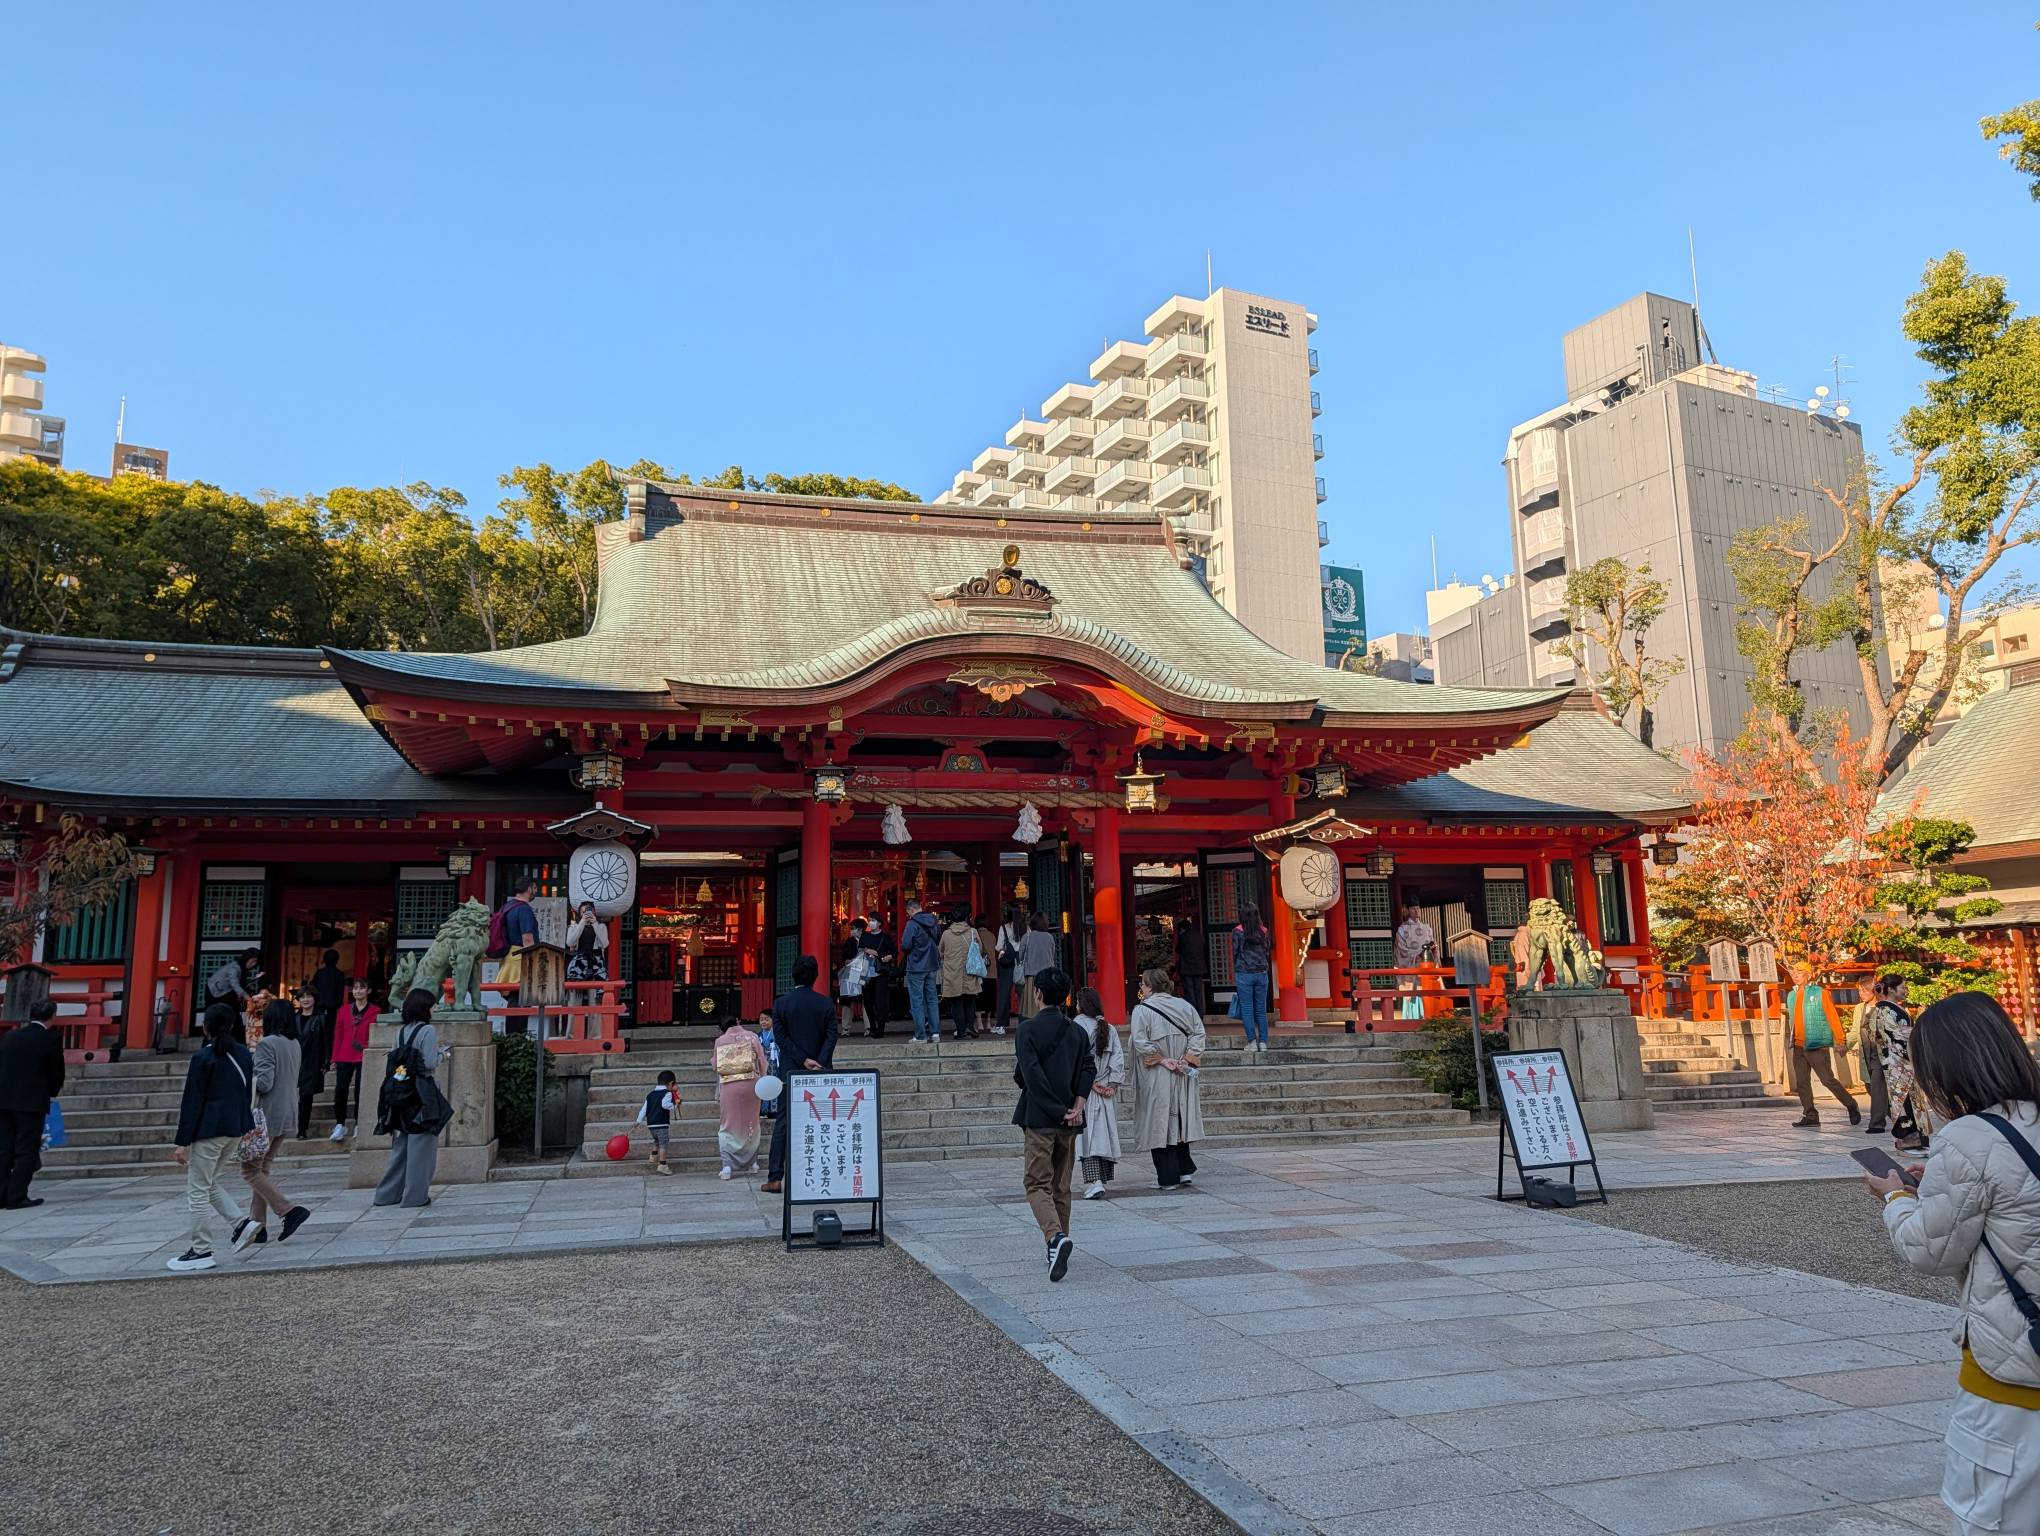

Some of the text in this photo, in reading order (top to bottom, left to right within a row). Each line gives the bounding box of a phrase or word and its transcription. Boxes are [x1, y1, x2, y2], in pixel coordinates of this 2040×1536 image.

[1245, 314, 1290, 333] エスリード
[794, 1078, 816, 1086] 参拝所
[852, 1077, 873, 1085] 参拝所
[1515, 1099, 1539, 1158] お進み下さい。
[1528, 1098, 1552, 1161] 空いている方へ
[1541, 1097, 1562, 1146] ございます。
[804, 1124, 815, 1191] お進み下さい。
[820, 1123, 831, 1196] 空いている方へ
[837, 1123, 847, 1180] ございます。
